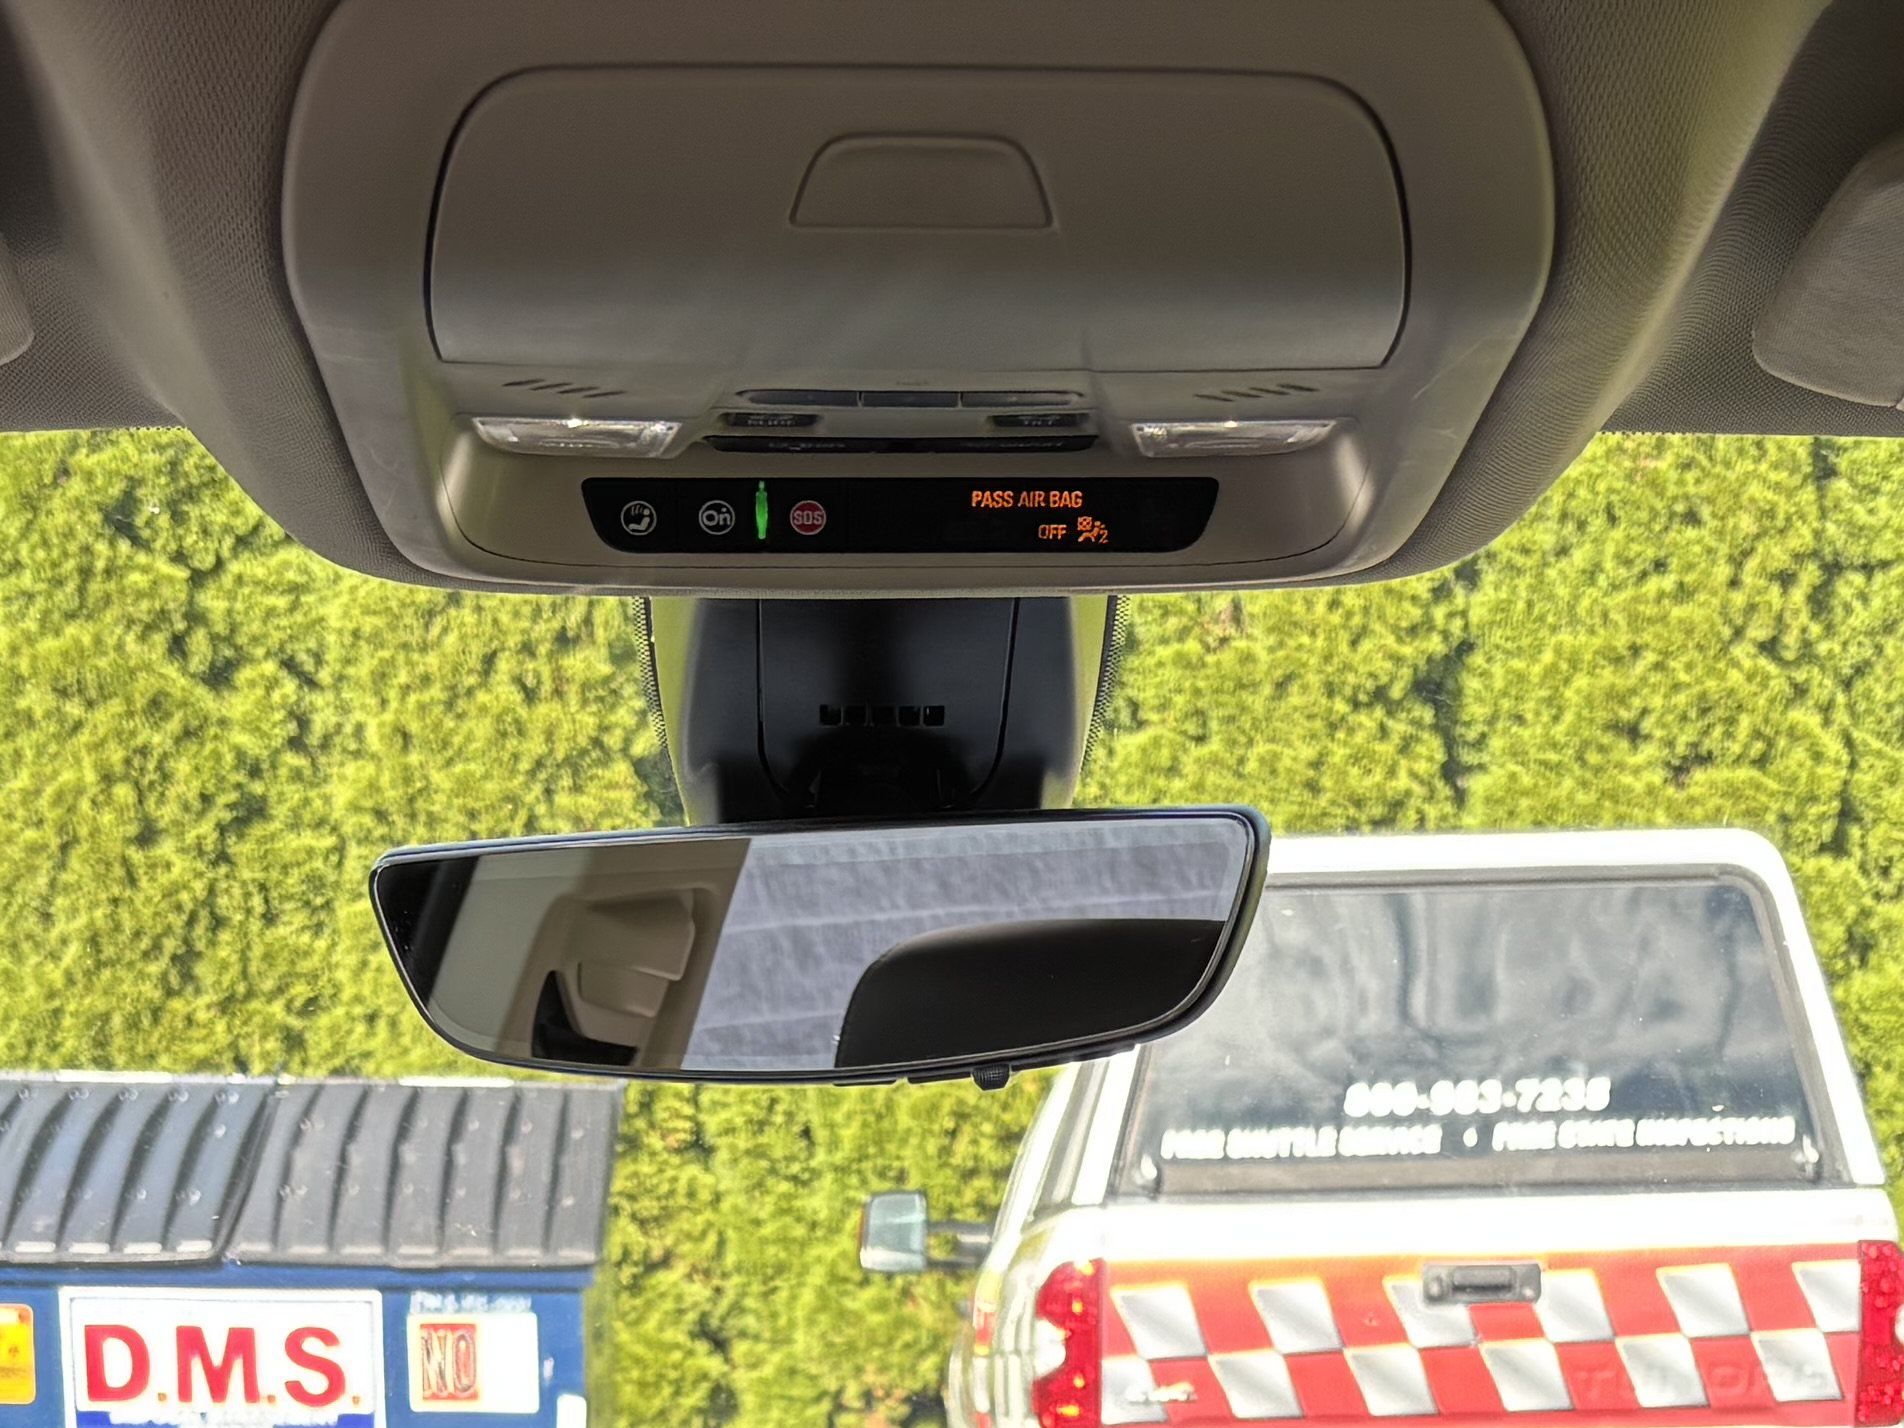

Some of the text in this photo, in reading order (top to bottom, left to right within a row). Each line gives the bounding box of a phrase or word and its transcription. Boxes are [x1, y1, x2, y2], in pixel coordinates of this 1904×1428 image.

[971, 490, 1083, 508] PASS AIR BAG
[793, 510, 823, 526] SOS
[1038, 524, 1068, 540] OFF
[84, 1324, 362, 1408] D.M.S.
[420, 1327, 477, 1394] NO
